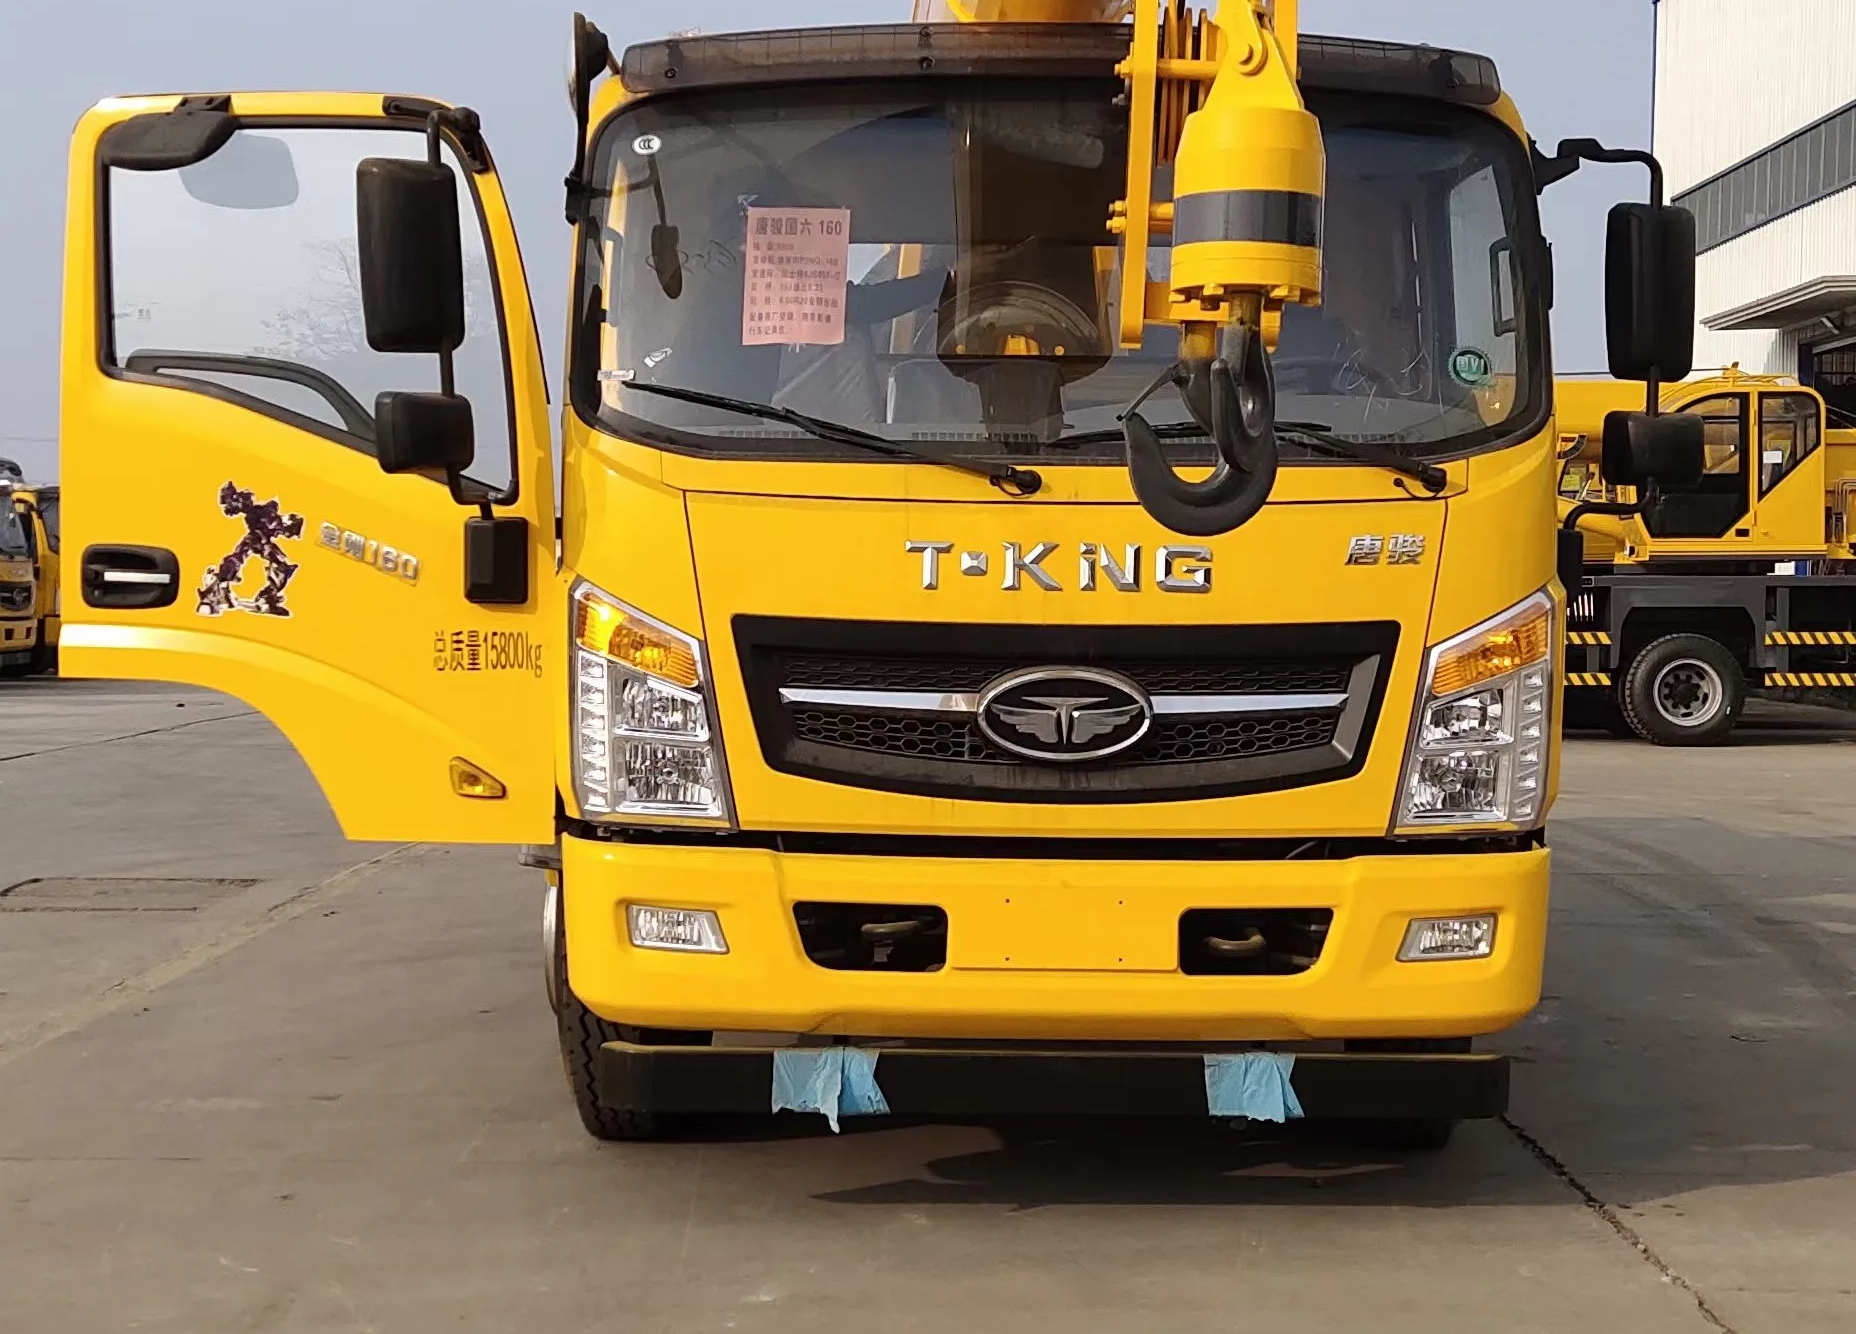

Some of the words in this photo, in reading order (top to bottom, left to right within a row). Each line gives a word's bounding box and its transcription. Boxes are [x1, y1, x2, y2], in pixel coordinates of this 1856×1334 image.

[755, 217, 813, 236] 唐骏国六
[819, 219, 842, 236] 160
[1344, 532, 1426, 567] 唐骏
[433, 629, 543, 679] 总质量15800kg
